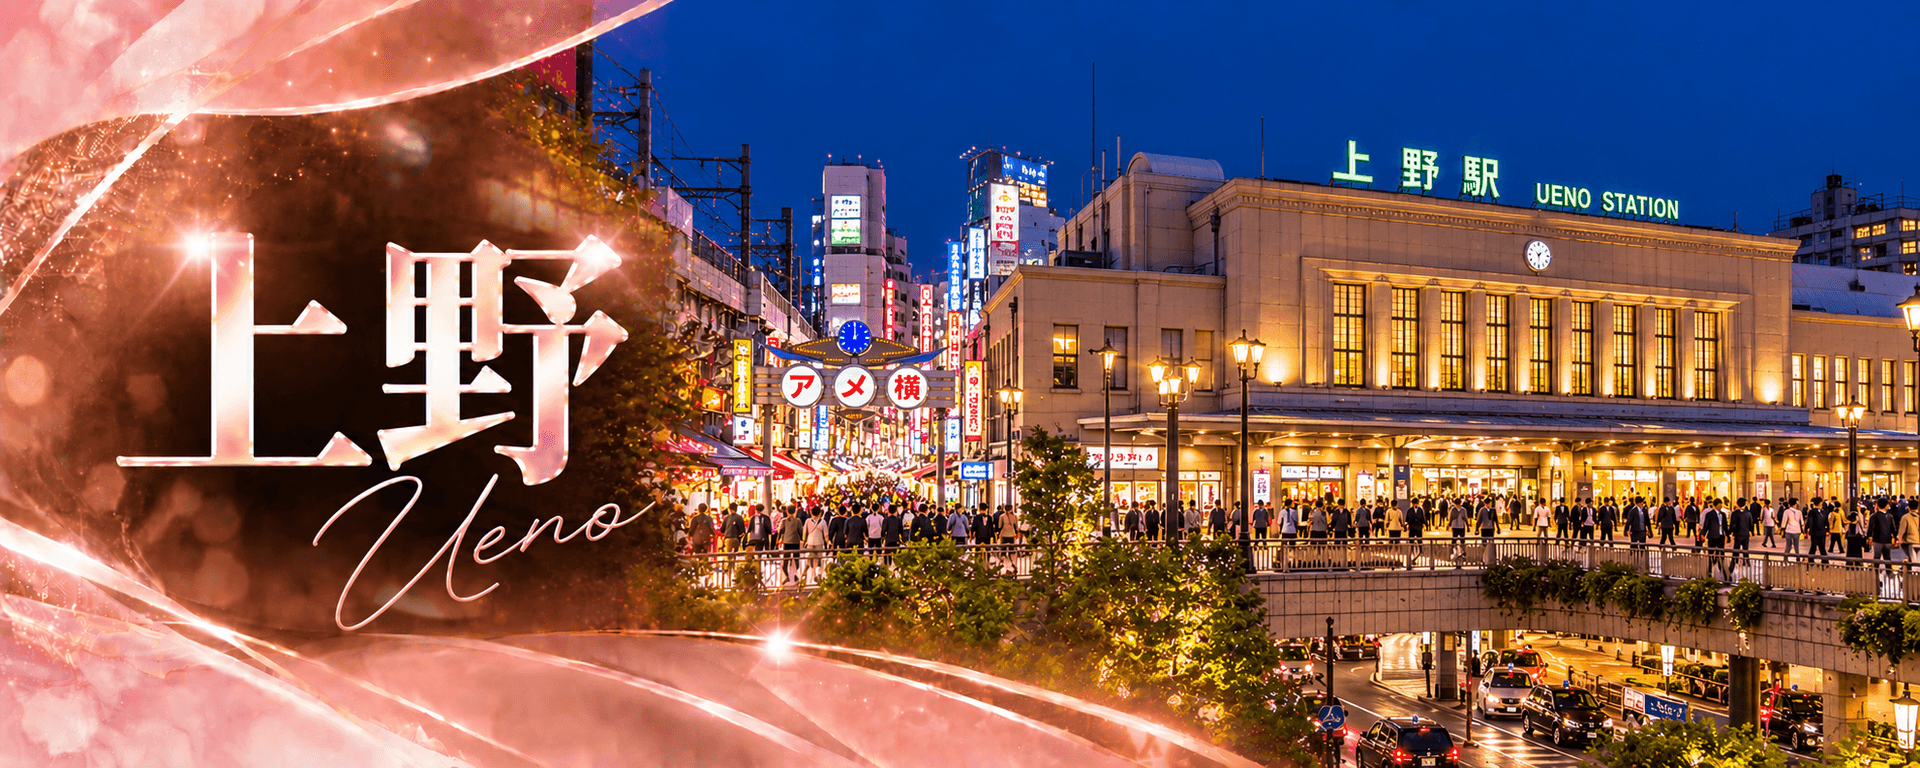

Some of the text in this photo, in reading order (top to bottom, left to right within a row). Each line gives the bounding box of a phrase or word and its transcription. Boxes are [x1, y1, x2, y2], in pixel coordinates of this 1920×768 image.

[1332, 139, 1500, 197] 上野駅
[1535, 183, 1680, 220] UENO STATION
[789, 374, 921, 401] アメ横
